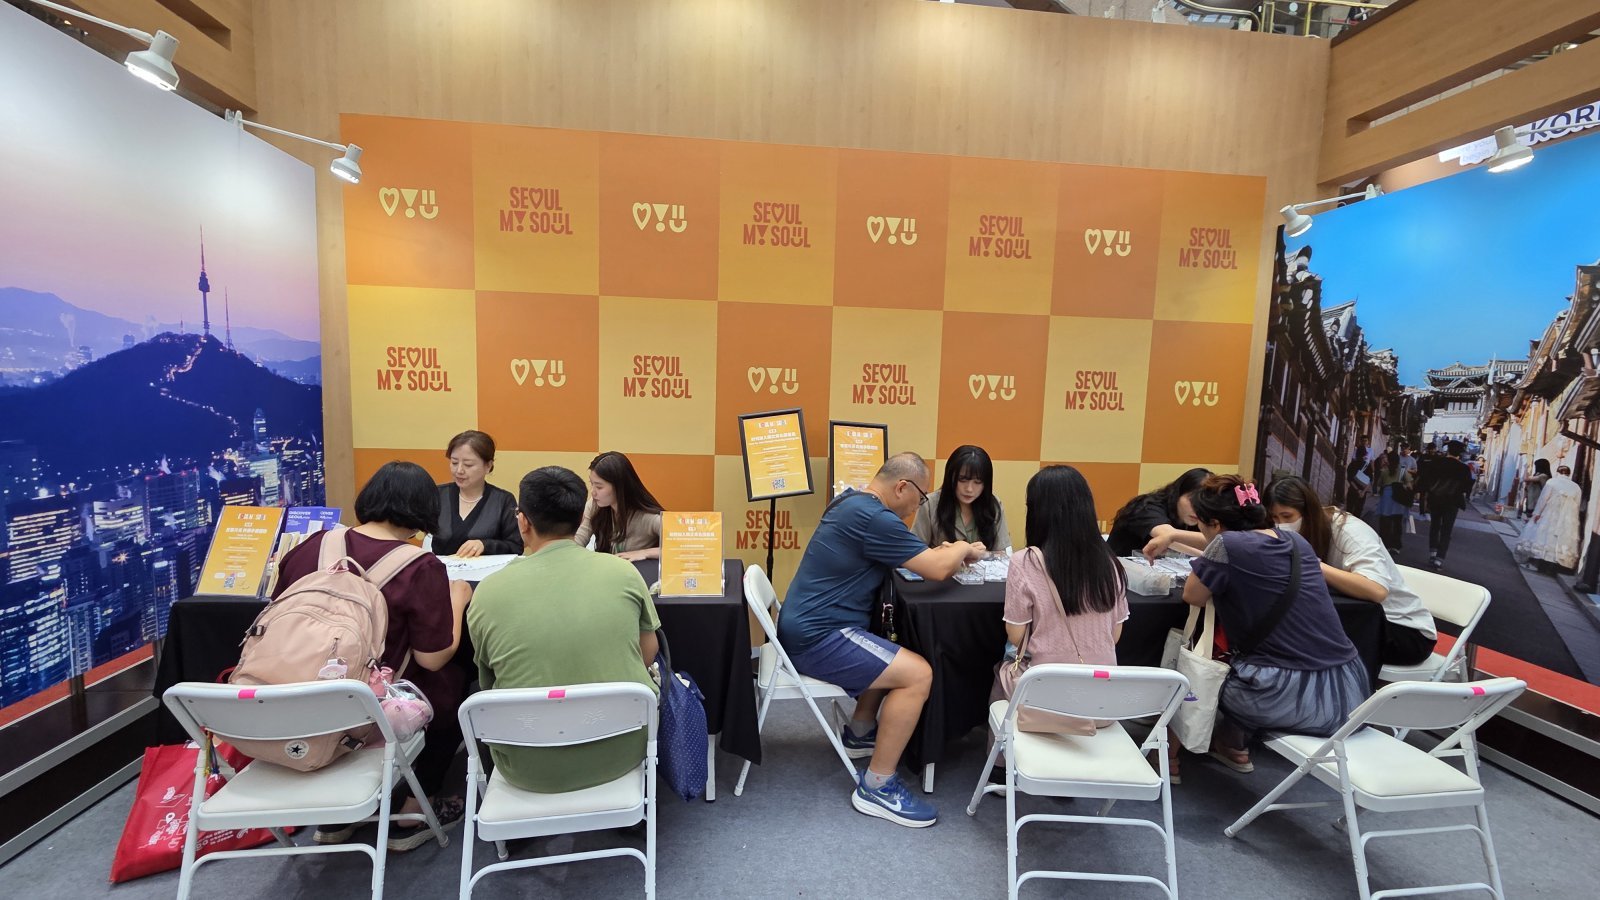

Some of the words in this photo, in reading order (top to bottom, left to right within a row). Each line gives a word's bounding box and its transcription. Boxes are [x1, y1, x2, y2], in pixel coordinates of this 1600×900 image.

[1529, 104, 1600, 142] KOR
[510, 187, 562, 210] SEOUL
[530, 212, 572, 234] SOUL
[754, 202, 802, 224] SEOUL
[771, 226, 810, 247] SOUL
[980, 215, 1024, 237] SEOUL
[995, 238, 1031, 259] SOUL
[1190, 228, 1231, 248] SEOUL
[1204, 250, 1237, 269] SOUL
[387, 347, 441, 369] SEOUL
[634, 355, 683, 376] SEOUL
[407, 370, 451, 392] SOUL
[863, 363, 908, 384] SEOUL
[1075, 371, 1118, 390] SEOUL
[651, 378, 692, 398] SOUL
[879, 385, 916, 405] SOUL
[1090, 392, 1124, 411] SOUL
